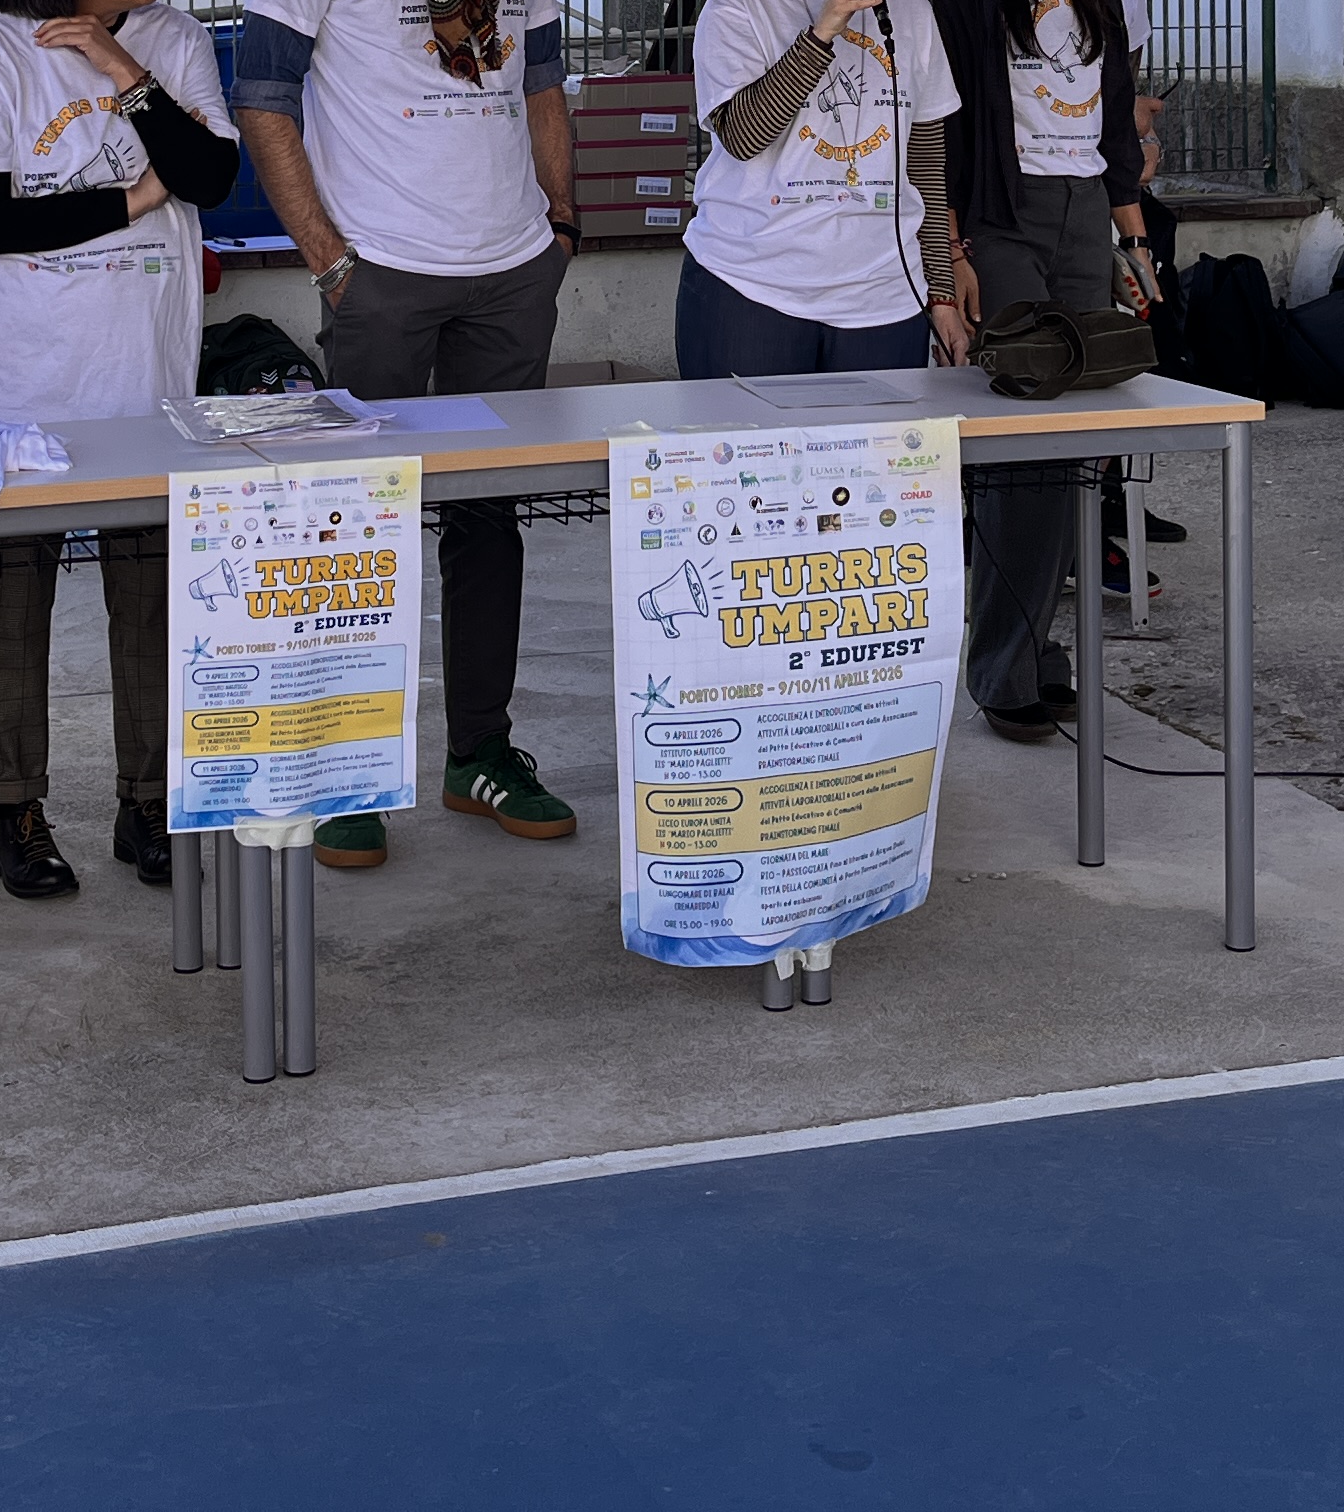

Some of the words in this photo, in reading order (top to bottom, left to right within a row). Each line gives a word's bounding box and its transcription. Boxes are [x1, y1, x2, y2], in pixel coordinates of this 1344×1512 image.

[399, 17, 429, 25] TORRES
[32, 98, 93, 156] TURRIS
[814, 124, 892, 161] EDUFEST
[24, 172, 58, 181] PORTO
[914, 456, 934, 466] SEA
[810, 466, 845, 476] LUMSA
[711, 478, 737, 486] rewind
[900, 490, 932, 500] CONAD
[255, 549, 397, 587] TURRIS
[731, 542, 928, 601] TURRIS
[245, 580, 396, 619] UMPARI
[294, 620, 309, 634] 2°
[315, 612, 392, 630] EDUFEST
[718, 588, 929, 648] UMPARI
[216, 643, 244, 656] PORTO
[286, 638, 321, 651] 9/10/11
[323, 633, 350, 645] APRILE
[789, 650, 811, 670] 2°
[821, 637, 926, 667] EDUFEST
[680, 688, 719, 704] PORTO
[722, 683, 764, 701] TORRES
[778, 676, 831, 696] 9/10/11
[834, 670, 869, 689] APRILE
[871, 664, 903, 683] 2026
[757, 711, 808, 724] ACCOGLIENZA
[815, 703, 863, 719] INTRODUZIONE
[664, 732, 670, 740] 9
[673, 731, 698, 740] APRILE
[700, 728, 723, 738] 2026
[758, 725, 789, 739] ATTIVITÀ
[791, 721, 845, 736] LABORATORIALI
[660, 749, 692, 758] ISTITUTO
[694, 747, 726, 757] NAUTICO
[769, 744, 789, 753] Patto
[790, 741, 824, 751] Educativo
[818, 752, 840, 763] FINALE
[759, 782, 809, 796] ACCOGLIENZA
[815, 773, 864, 789] INTRODUZIONE
[664, 798, 675, 807] 10
[677, 797, 702, 807] APRILE
[704, 796, 728, 806] 2026
[658, 818, 679, 828] LICEO
[681, 818, 708, 827] EUROPA
[761, 852, 796, 865] GIORNATA
[798, 851, 810, 860] DEL
[664, 870, 672, 879] 11
[674, 870, 700, 879] APRILE
[702, 868, 725, 879] 2026
[782, 863, 828, 878] PASSEGGIATA
[761, 885, 781, 896] FESTA
[782, 881, 802, 893] DELLA
[803, 873, 837, 890] COMUNITÀ
[710, 918, 733, 928] 19.00
